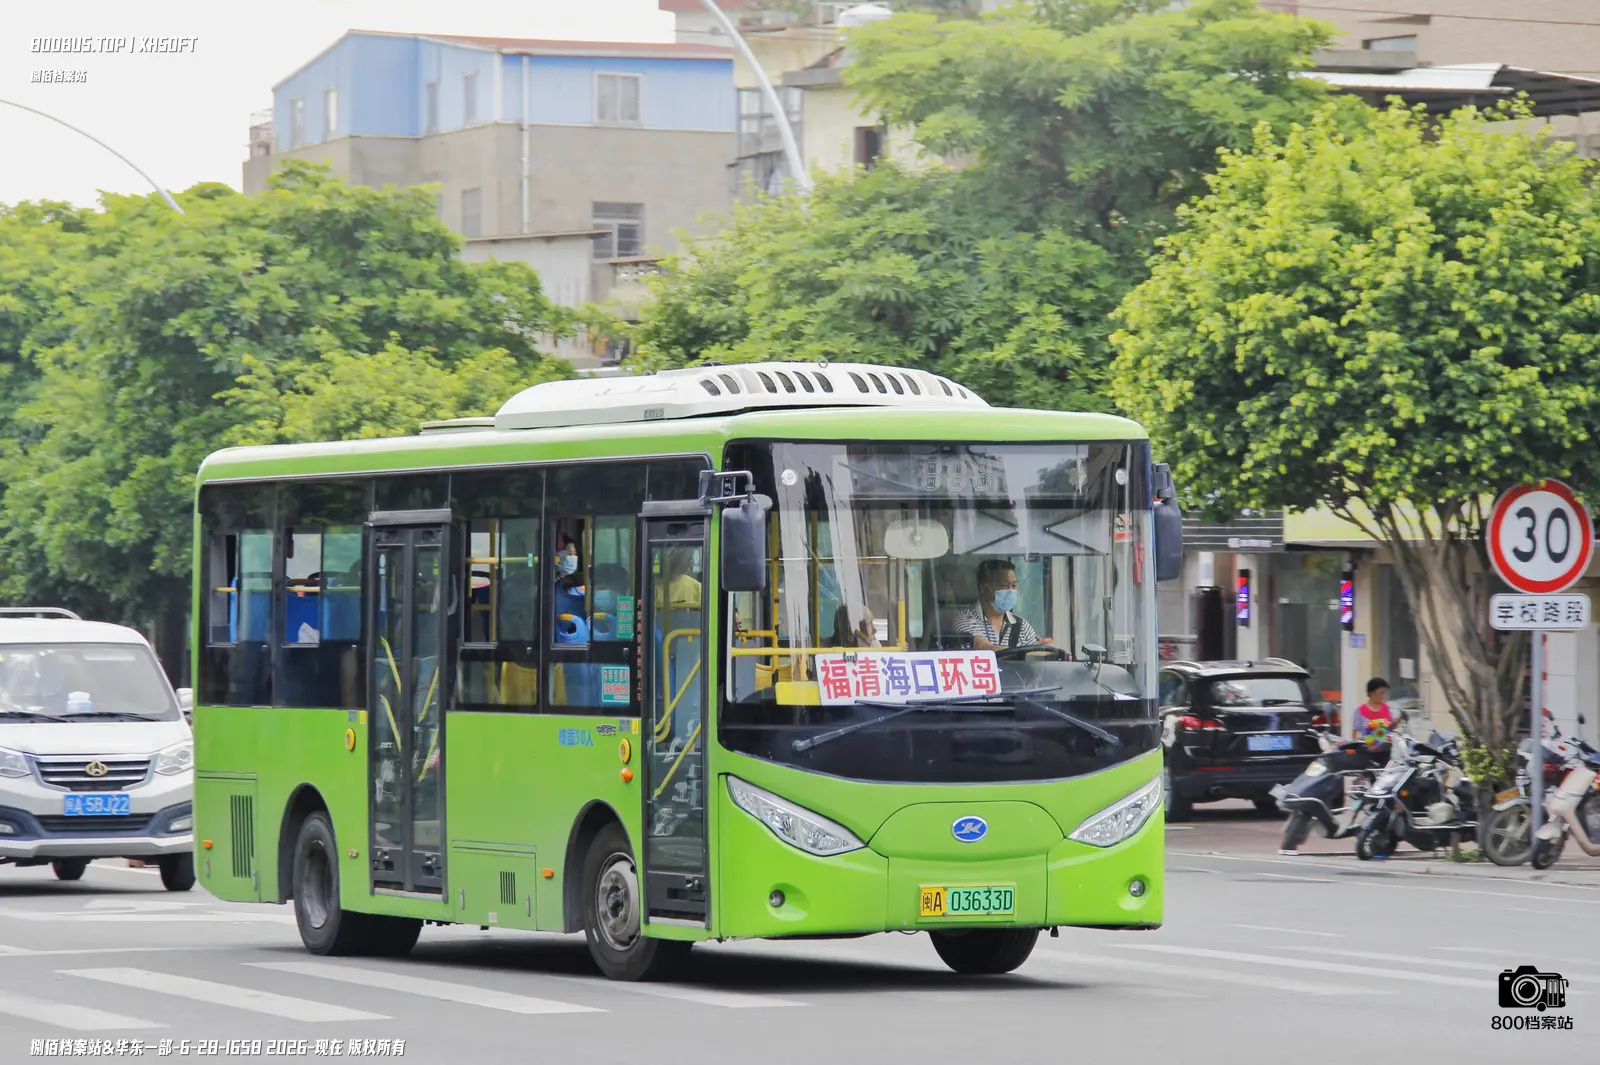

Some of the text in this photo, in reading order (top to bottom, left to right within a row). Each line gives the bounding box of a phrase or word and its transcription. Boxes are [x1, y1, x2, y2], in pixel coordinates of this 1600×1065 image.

[1512, 506, 1570, 563] 30
[1497, 601, 1583, 623] 学校路段
[820, 656, 997, 699] 福清海口环岛
